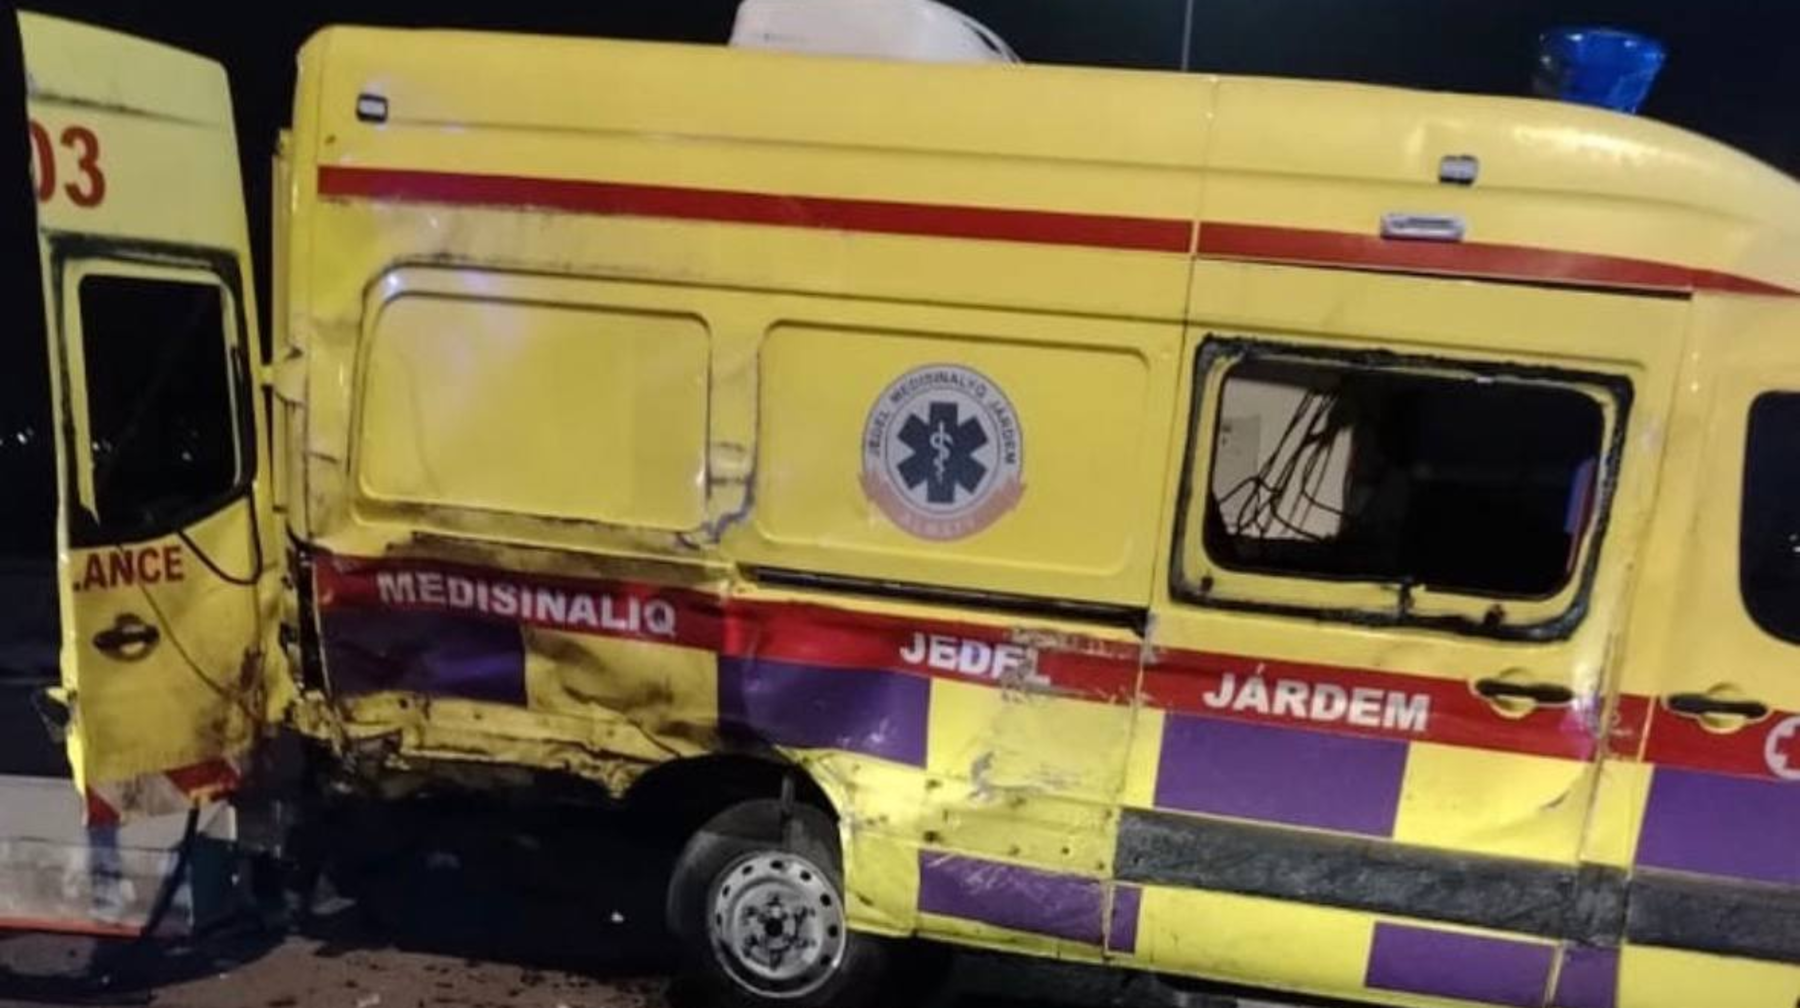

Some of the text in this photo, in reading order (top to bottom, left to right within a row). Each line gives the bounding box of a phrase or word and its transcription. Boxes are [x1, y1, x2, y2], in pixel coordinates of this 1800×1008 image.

[73, 545, 184, 592] ANCE
[376, 572, 677, 636] MEDISINALIQ
[1203, 662, 1431, 732] JÁRDEM
